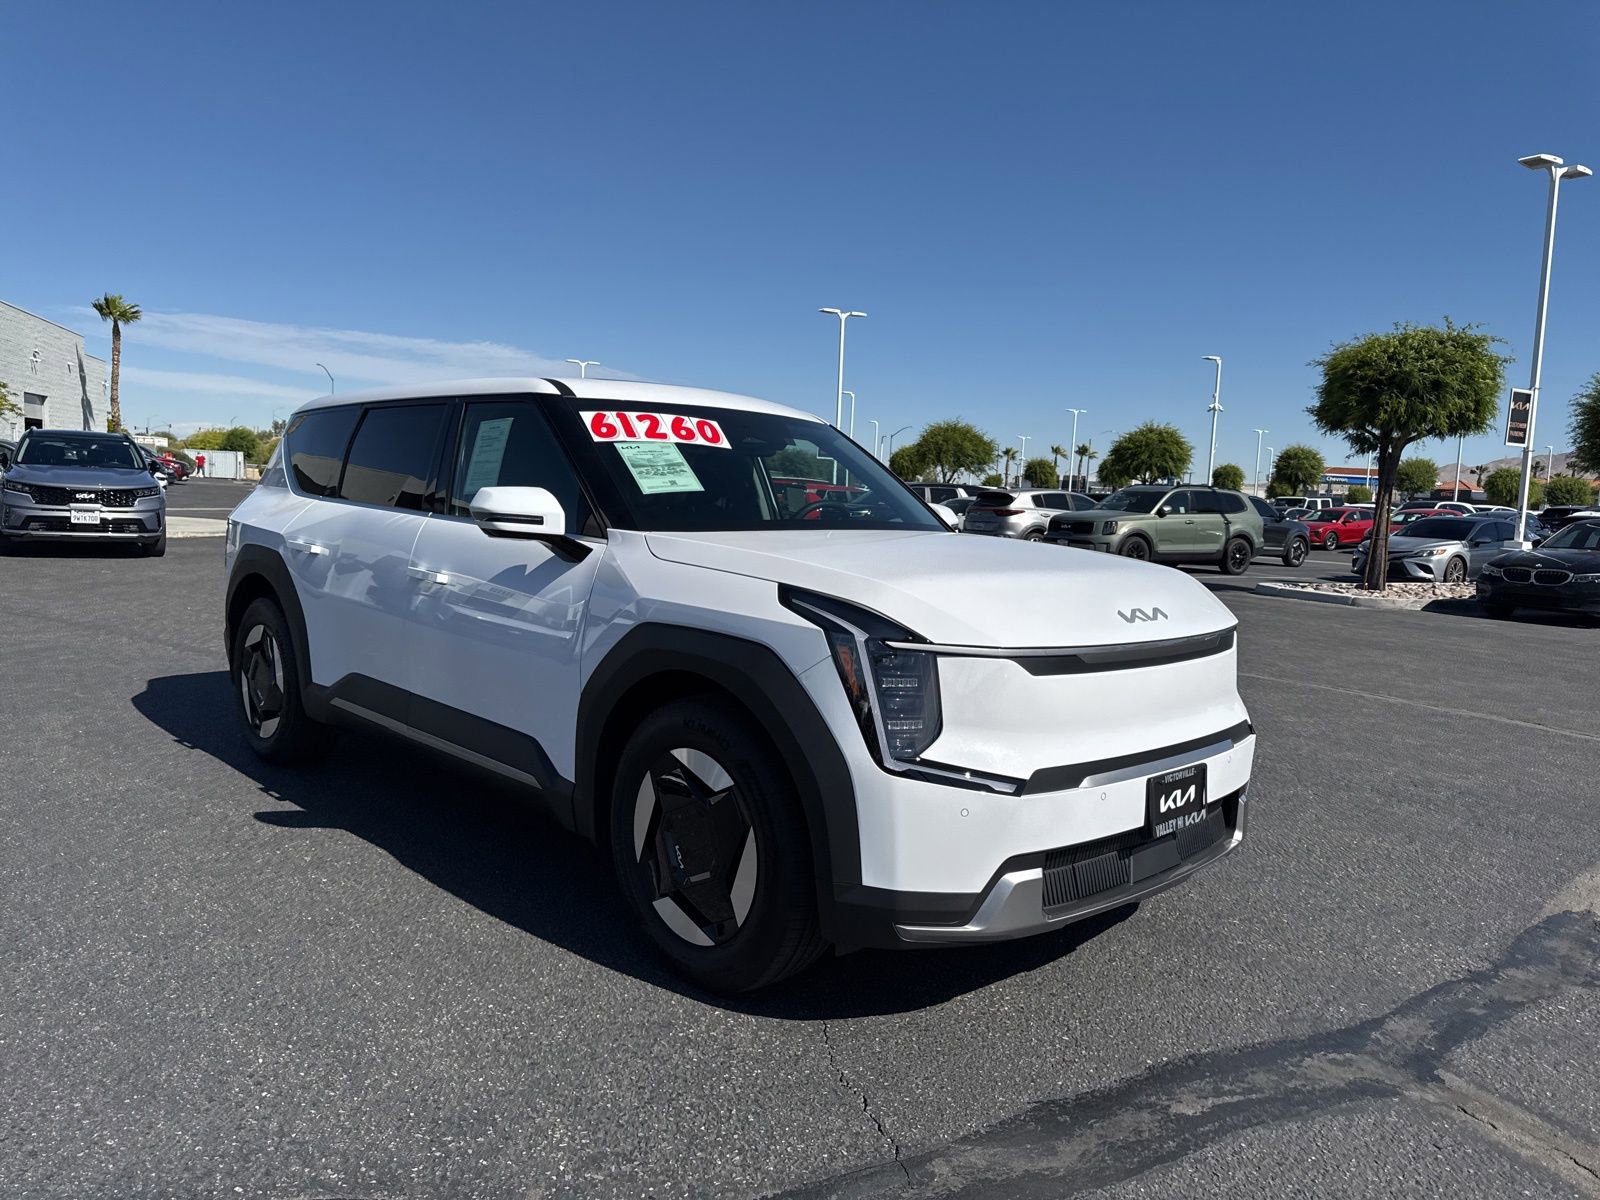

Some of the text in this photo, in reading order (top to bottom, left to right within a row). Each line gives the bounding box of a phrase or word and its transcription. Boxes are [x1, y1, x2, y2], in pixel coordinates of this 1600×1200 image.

[1510, 401, 1530, 410] KIA
[591, 412, 722, 444] 61260
[1117, 607, 1168, 624] KIA
[1164, 767, 1195, 783] VICTORVILLE
[1160, 784, 1196, 813] KIA
[1155, 808, 1207, 838] VALLEY HI KIA
